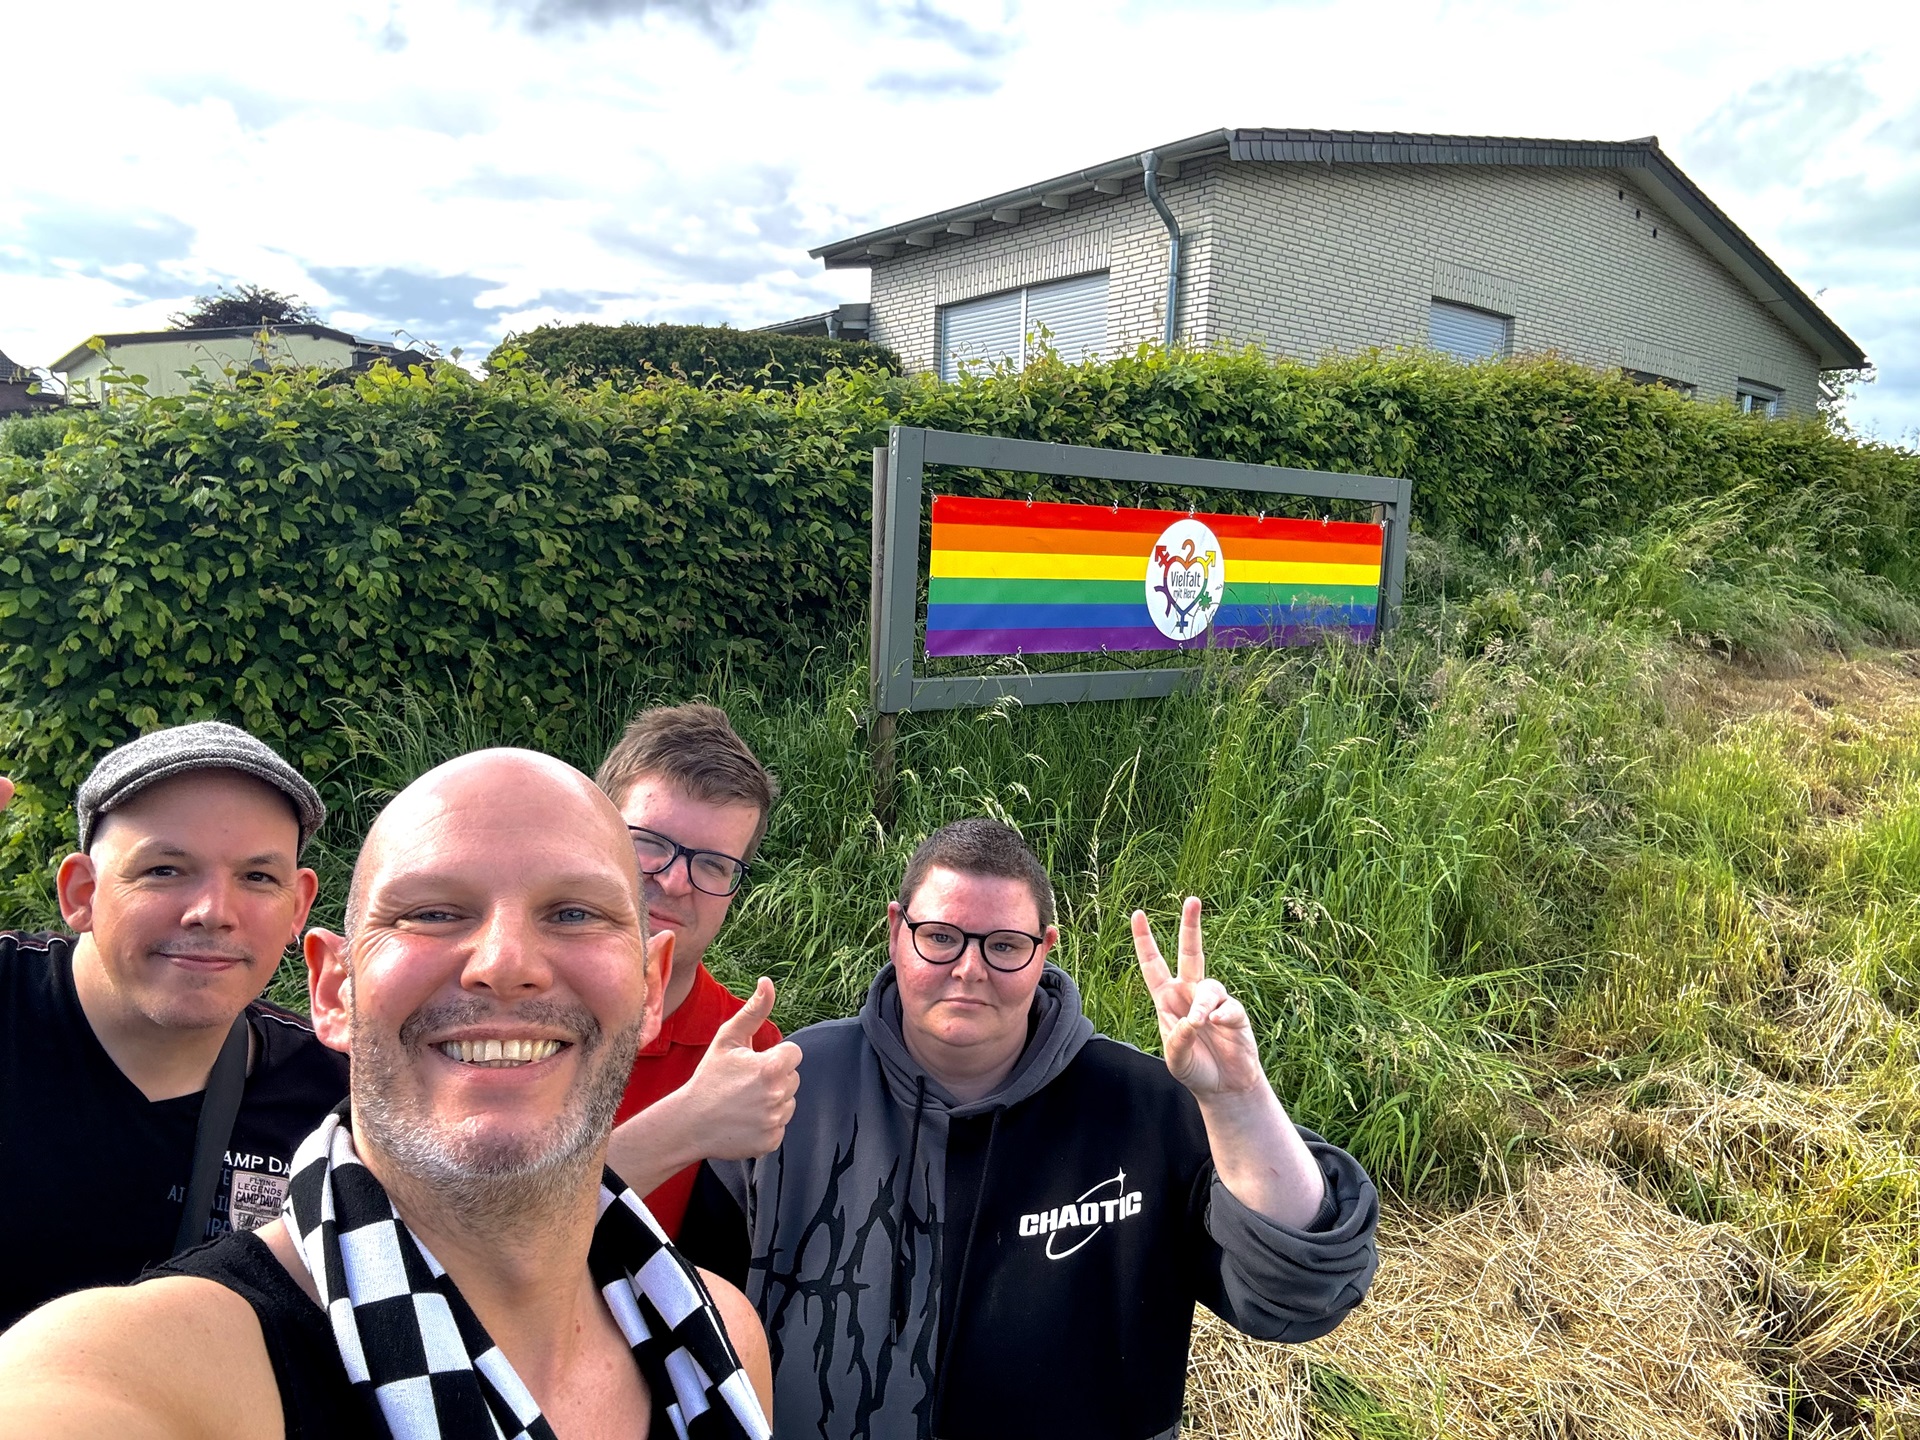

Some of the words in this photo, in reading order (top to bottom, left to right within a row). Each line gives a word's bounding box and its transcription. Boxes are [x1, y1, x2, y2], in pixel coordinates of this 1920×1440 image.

[1171, 571, 1201, 587] Vielfalt
[1173, 588, 1182, 599] mit
[1183, 588, 1196, 599] Herz
[223, 1150, 264, 1169] AMP
[268, 1156, 291, 1176] DA
[237, 1182, 283, 1197] LEGENDS
[249, 1177, 277, 1187] FLYING
[236, 1191, 260, 1205] CAMP
[260, 1194, 282, 1209] DAVID
[1018, 1191, 1143, 1237] CHAOTIC
